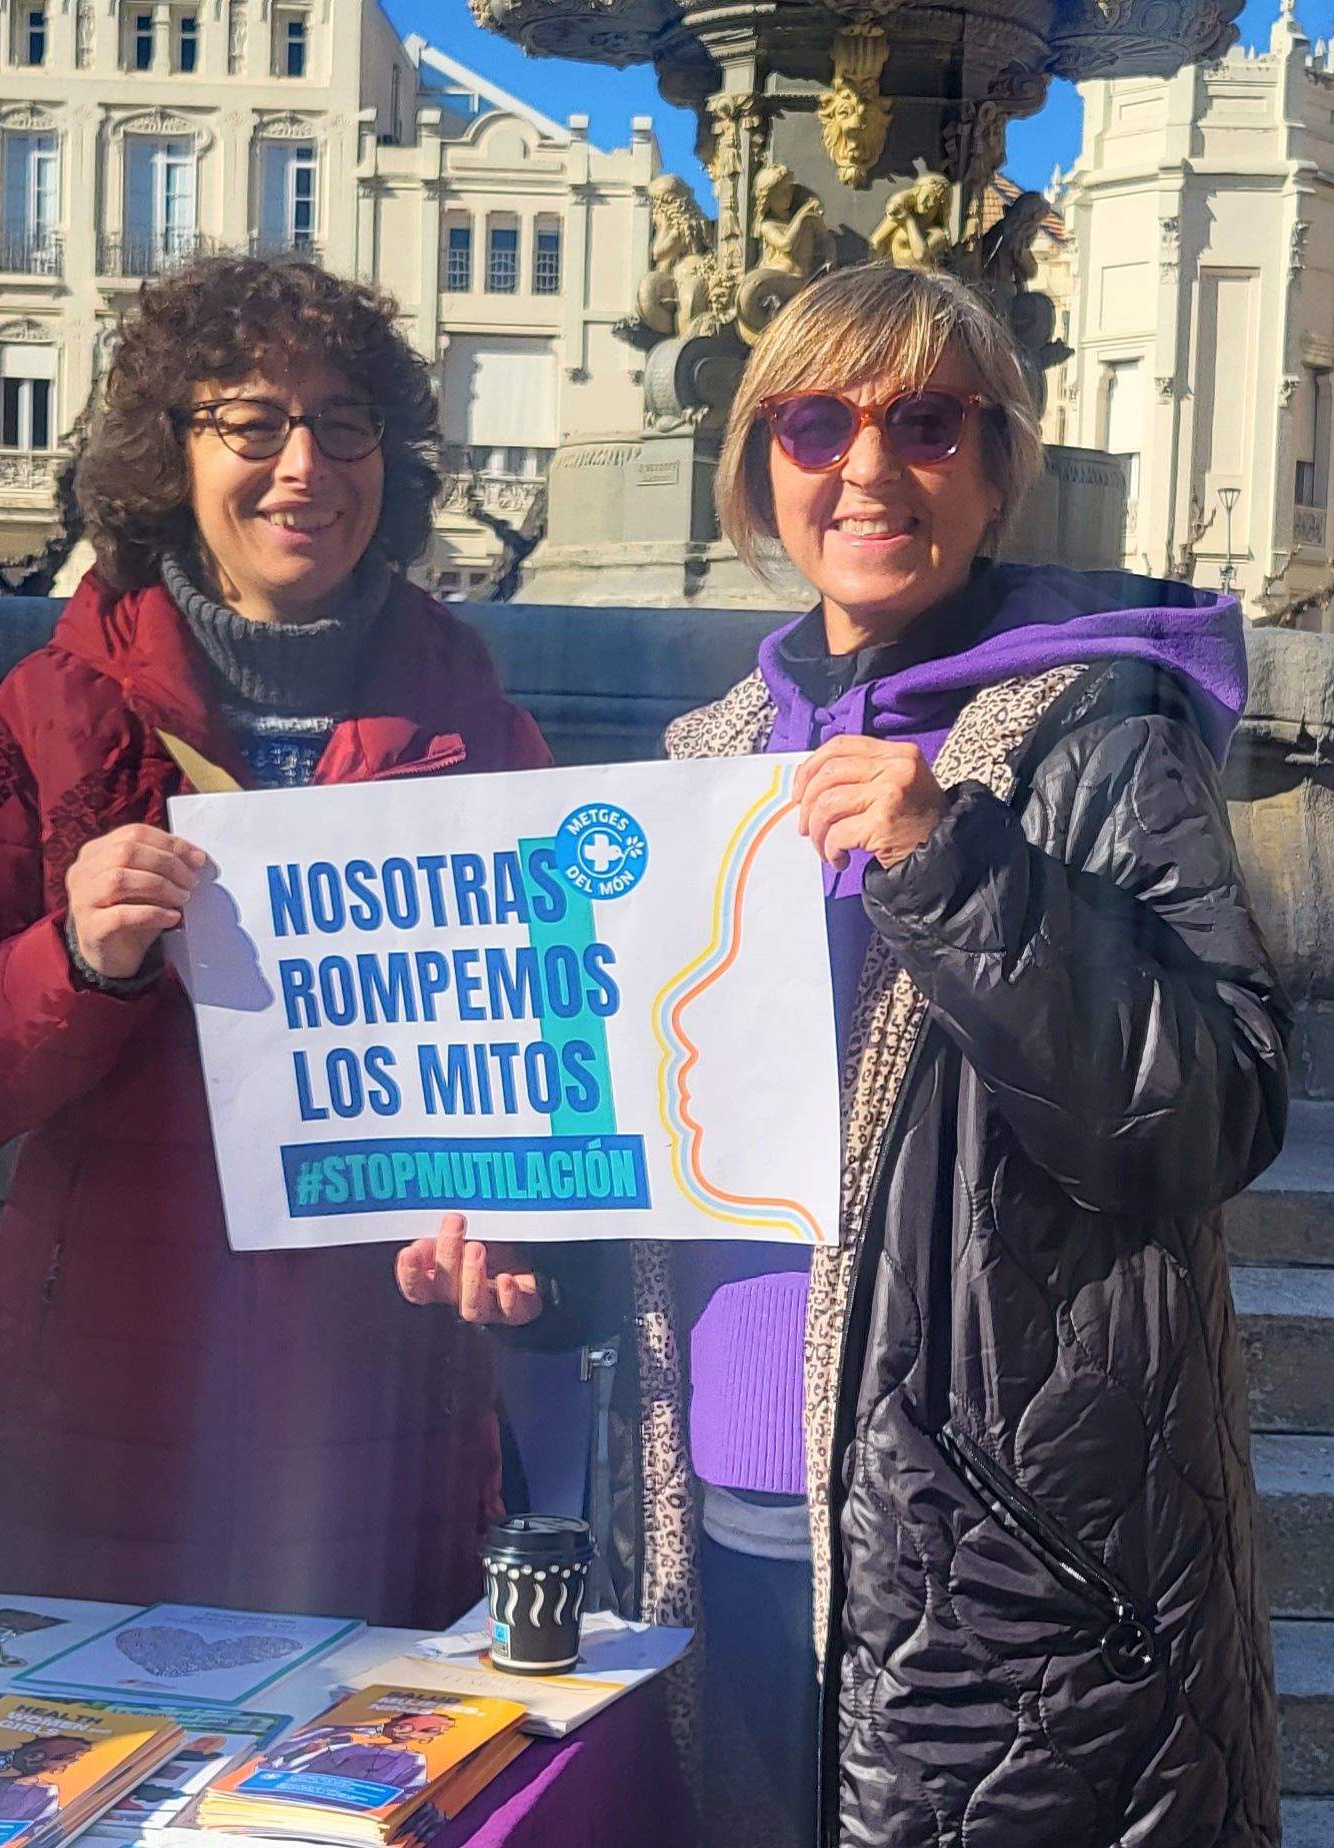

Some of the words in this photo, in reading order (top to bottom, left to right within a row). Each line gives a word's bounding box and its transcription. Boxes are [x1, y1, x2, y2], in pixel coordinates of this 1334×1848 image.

[566, 809, 629, 835] METGES
[266, 847, 568, 937] NOSOTRAS
[566, 865, 593, 893] DEL
[278, 944, 621, 1030] ROMPEMOS
[293, 1044, 401, 1122] LOS
[417, 1041, 601, 1116] MITOS
[296, 1139, 637, 1206] #STOPMUTILACIÓN
[14, 1704, 104, 1725] HEALTH
